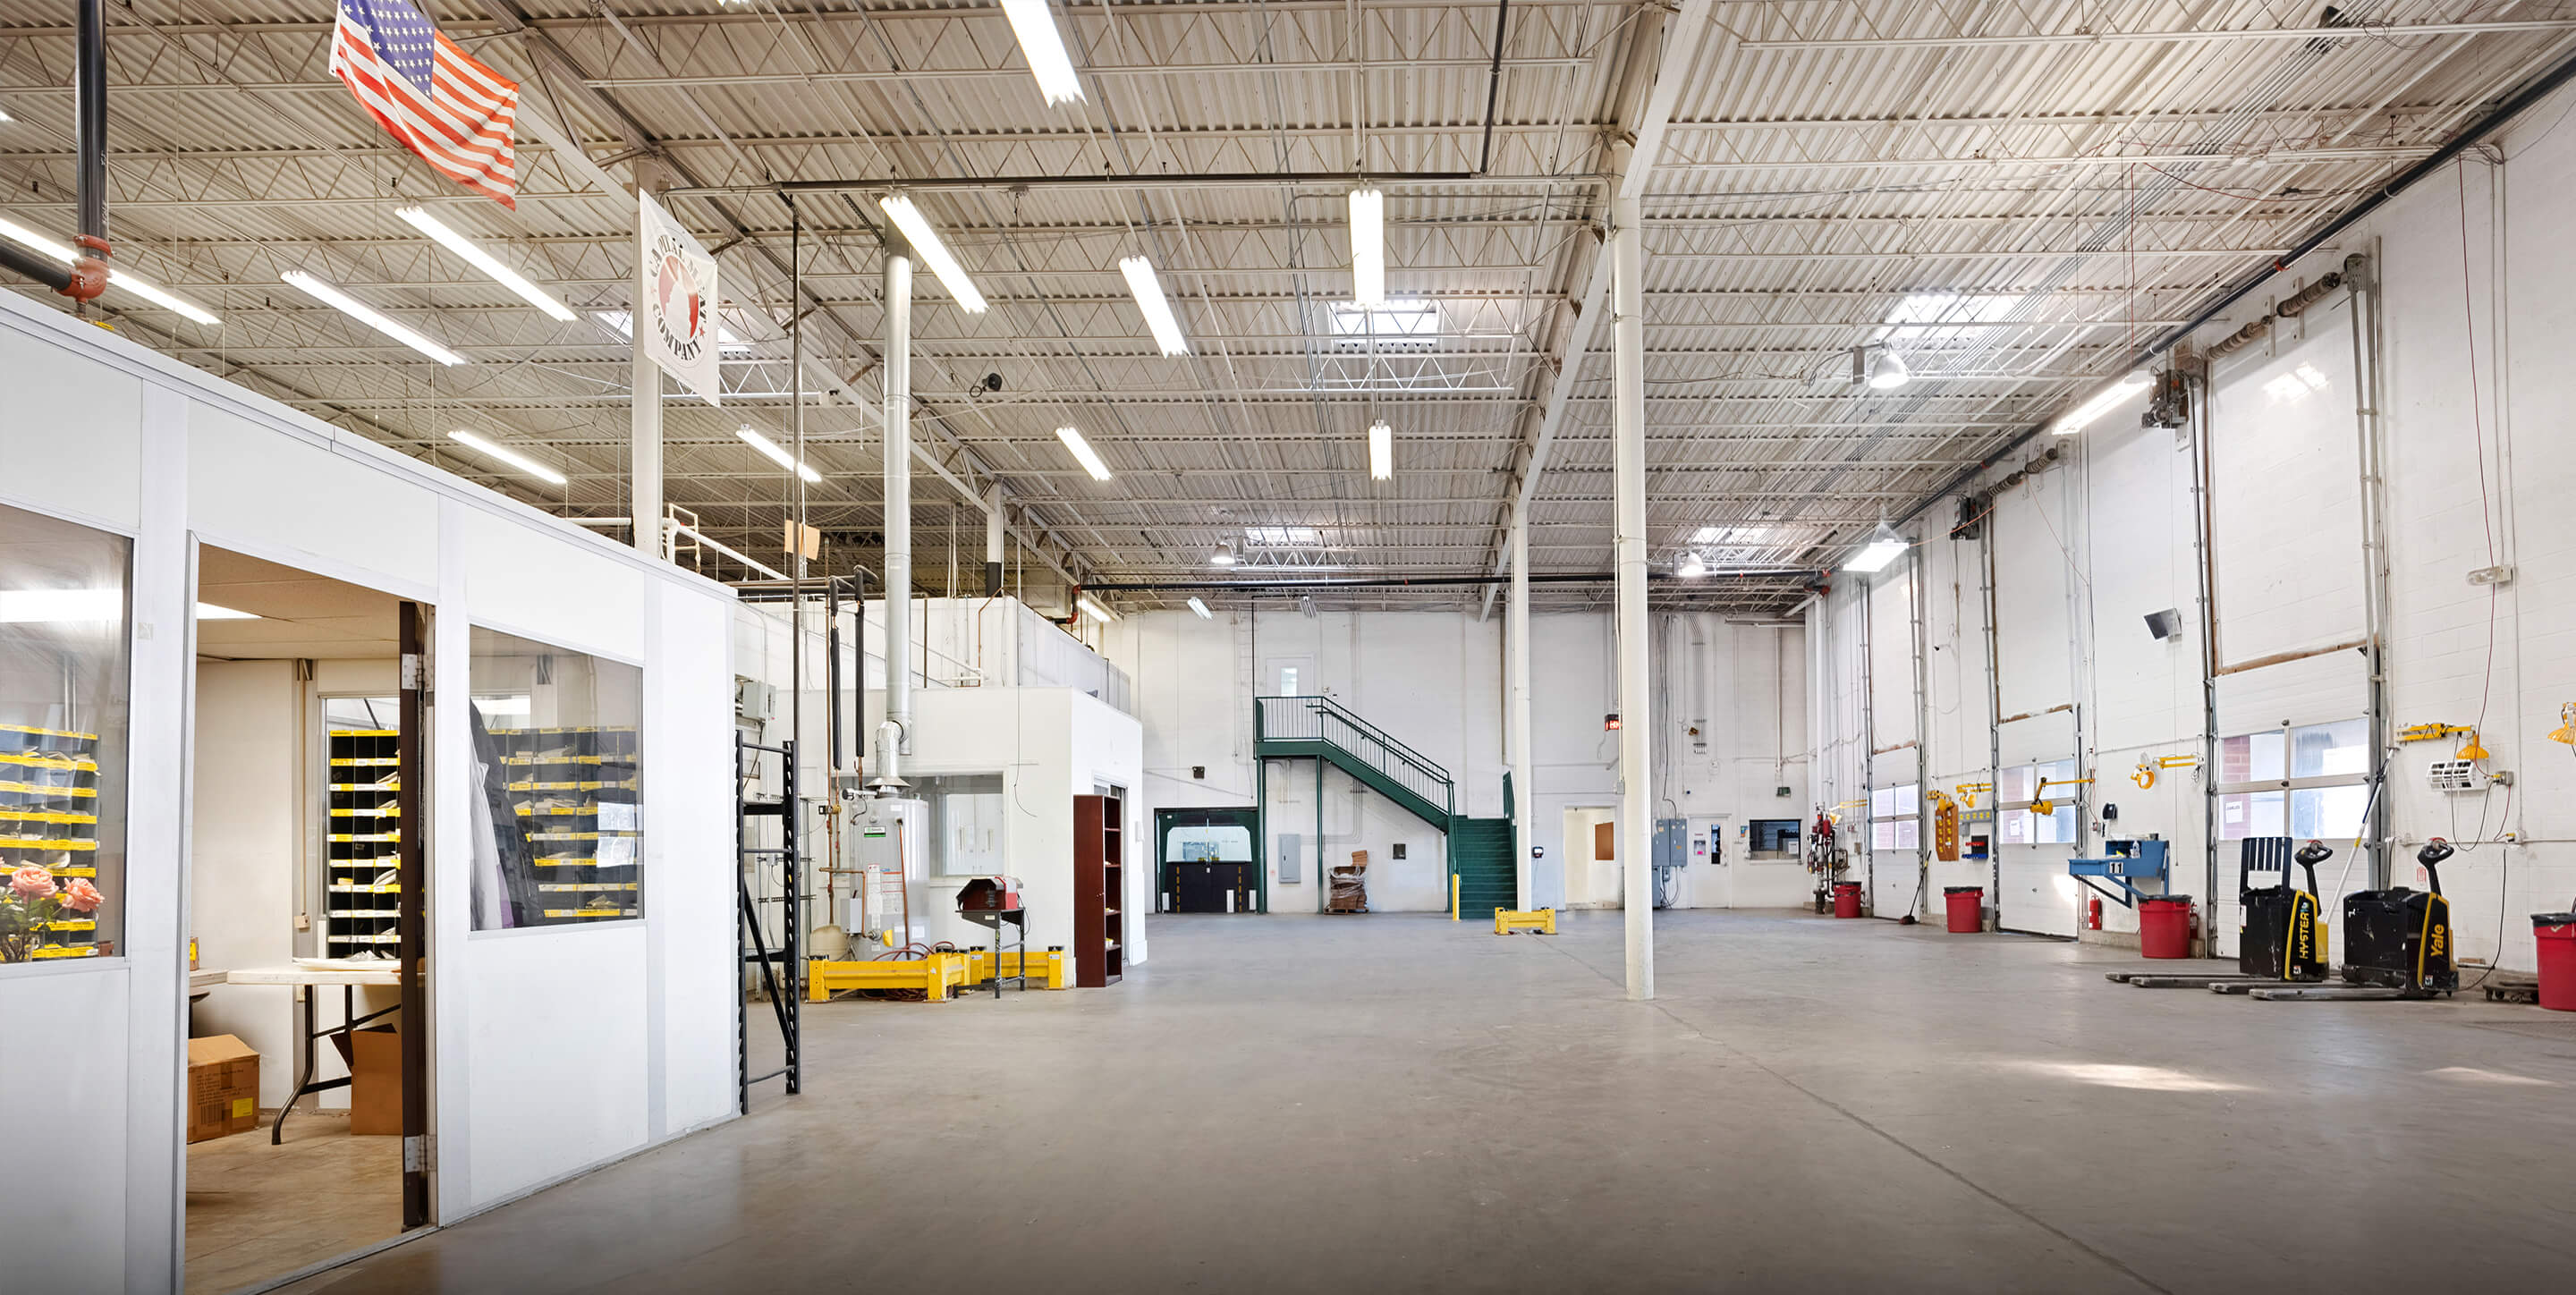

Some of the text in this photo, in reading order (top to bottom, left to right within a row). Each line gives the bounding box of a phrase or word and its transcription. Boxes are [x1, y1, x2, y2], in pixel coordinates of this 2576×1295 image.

[649, 234, 685, 278] CAPITAL
[652, 302, 702, 361] COMPANY
[2299, 912, 2309, 960] HYSTER
[2430, 924, 2445, 957] Yale
